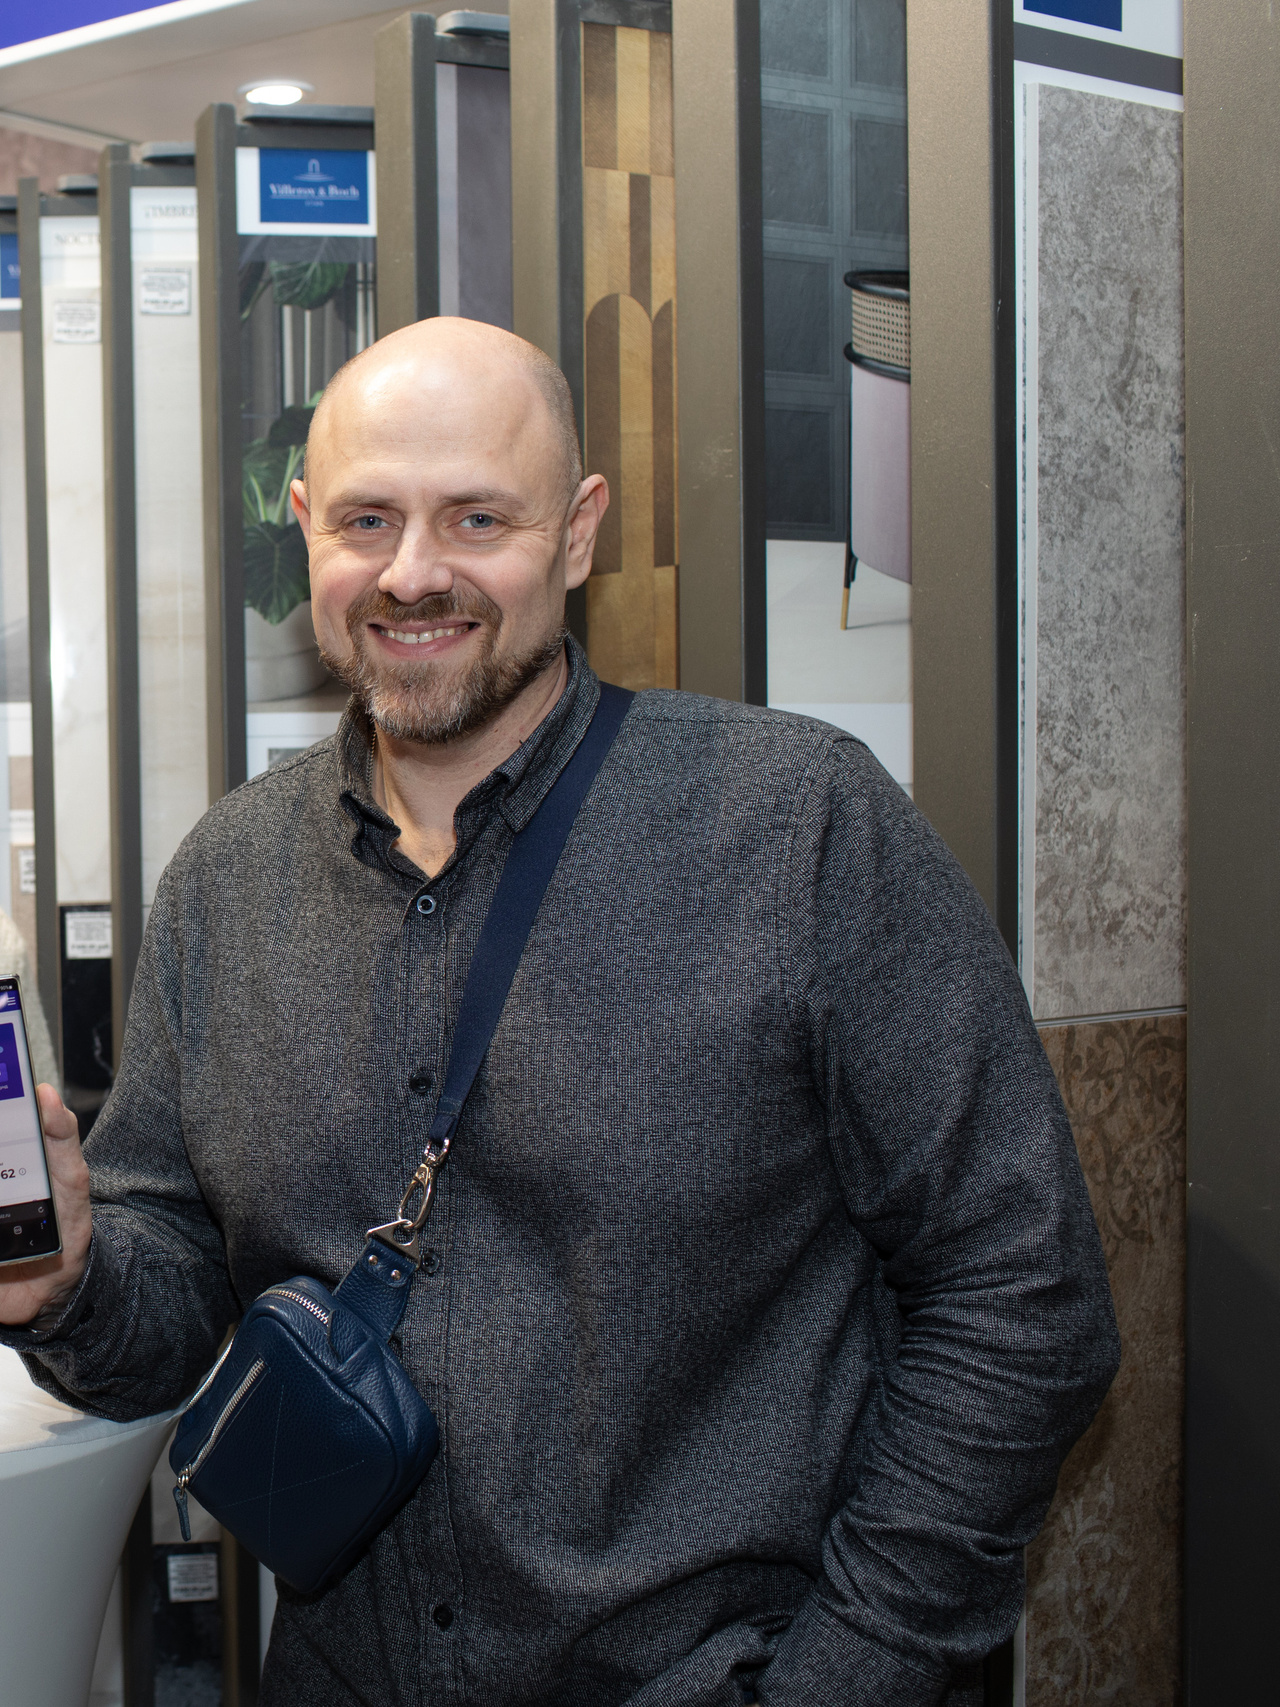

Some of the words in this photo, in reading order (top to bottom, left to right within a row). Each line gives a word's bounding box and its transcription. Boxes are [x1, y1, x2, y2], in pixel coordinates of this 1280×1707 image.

[269, 183, 315, 198] Villeroy
[317, 184, 326, 197] &
[327, 184, 360, 197] Boch
